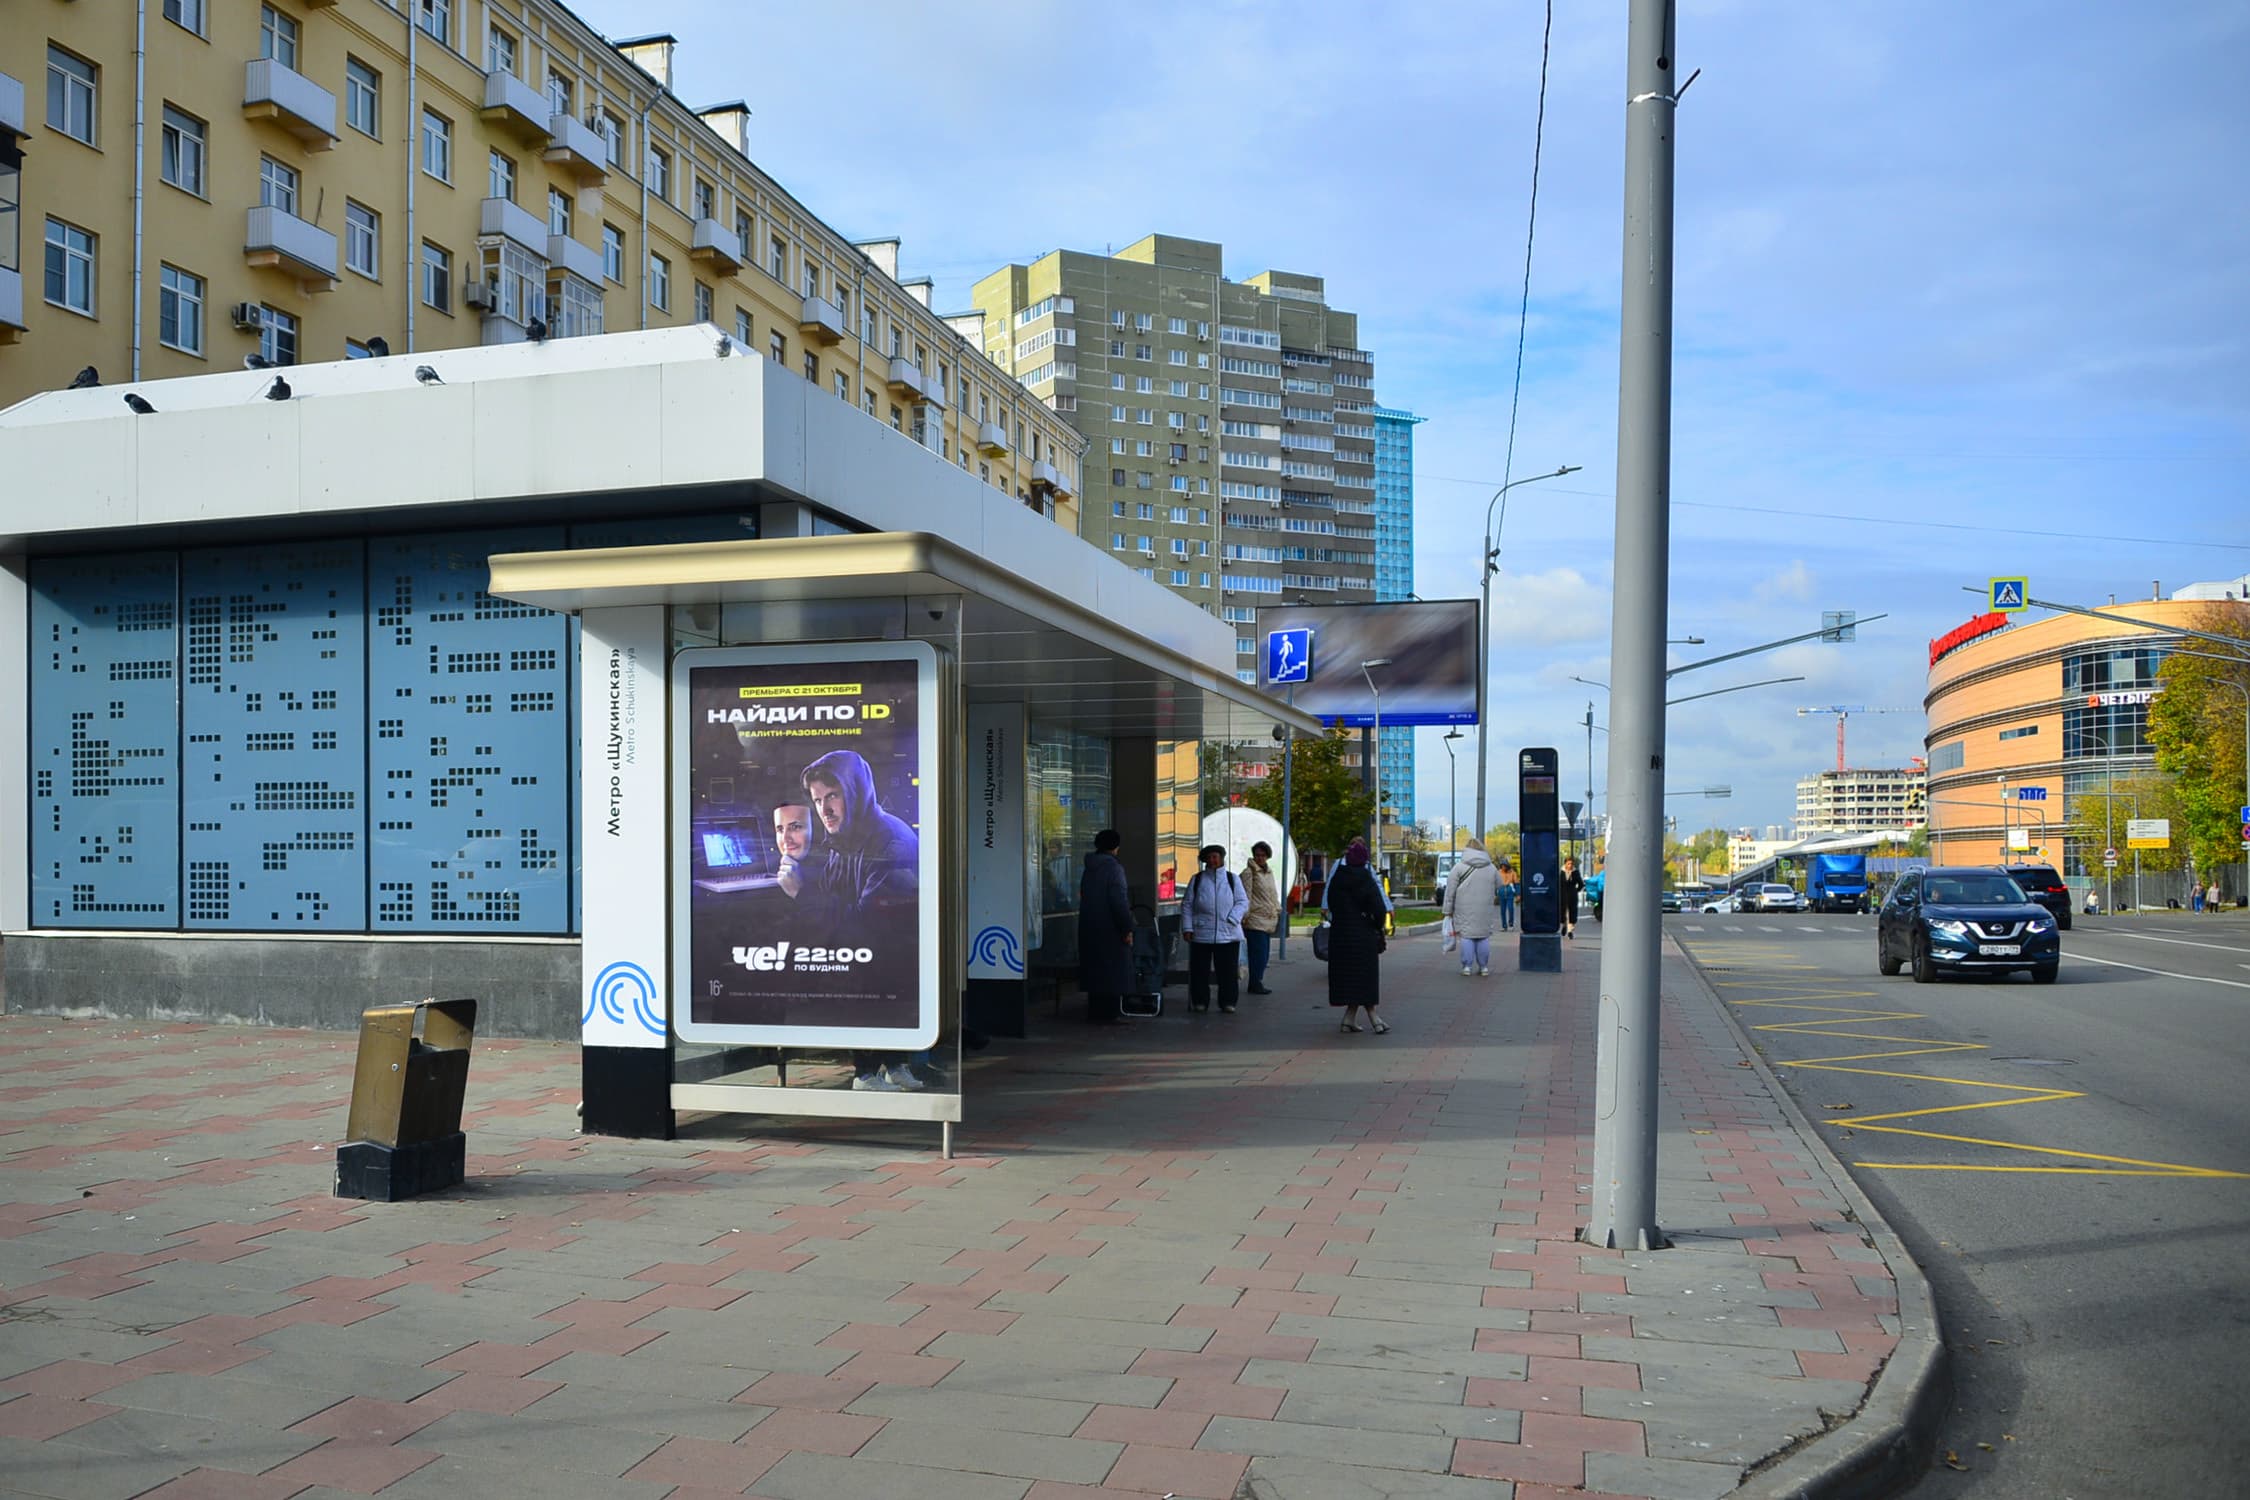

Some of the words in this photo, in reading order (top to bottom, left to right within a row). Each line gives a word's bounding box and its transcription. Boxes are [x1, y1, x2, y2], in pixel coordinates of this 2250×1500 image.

[626, 647, 637, 724] Schukinskaya
[743, 687, 791, 696] ПРЕМЬЕРА
[814, 685, 858, 694] ОКТЯБРЯ
[2100, 692, 2156, 706] ЧЕТЫР
[607, 649, 623, 770] «Щукинская»
[707, 704, 808, 724] НАЙДИ
[814, 705, 855, 721] ПО
[861, 704, 890, 719] ID
[626, 728, 635, 765] Metro
[607, 776, 623, 836] Метро
[984, 809, 995, 849] Метро
[794, 947, 873, 963] 22:00
[809, 964, 849, 972] БУДНЯМ
